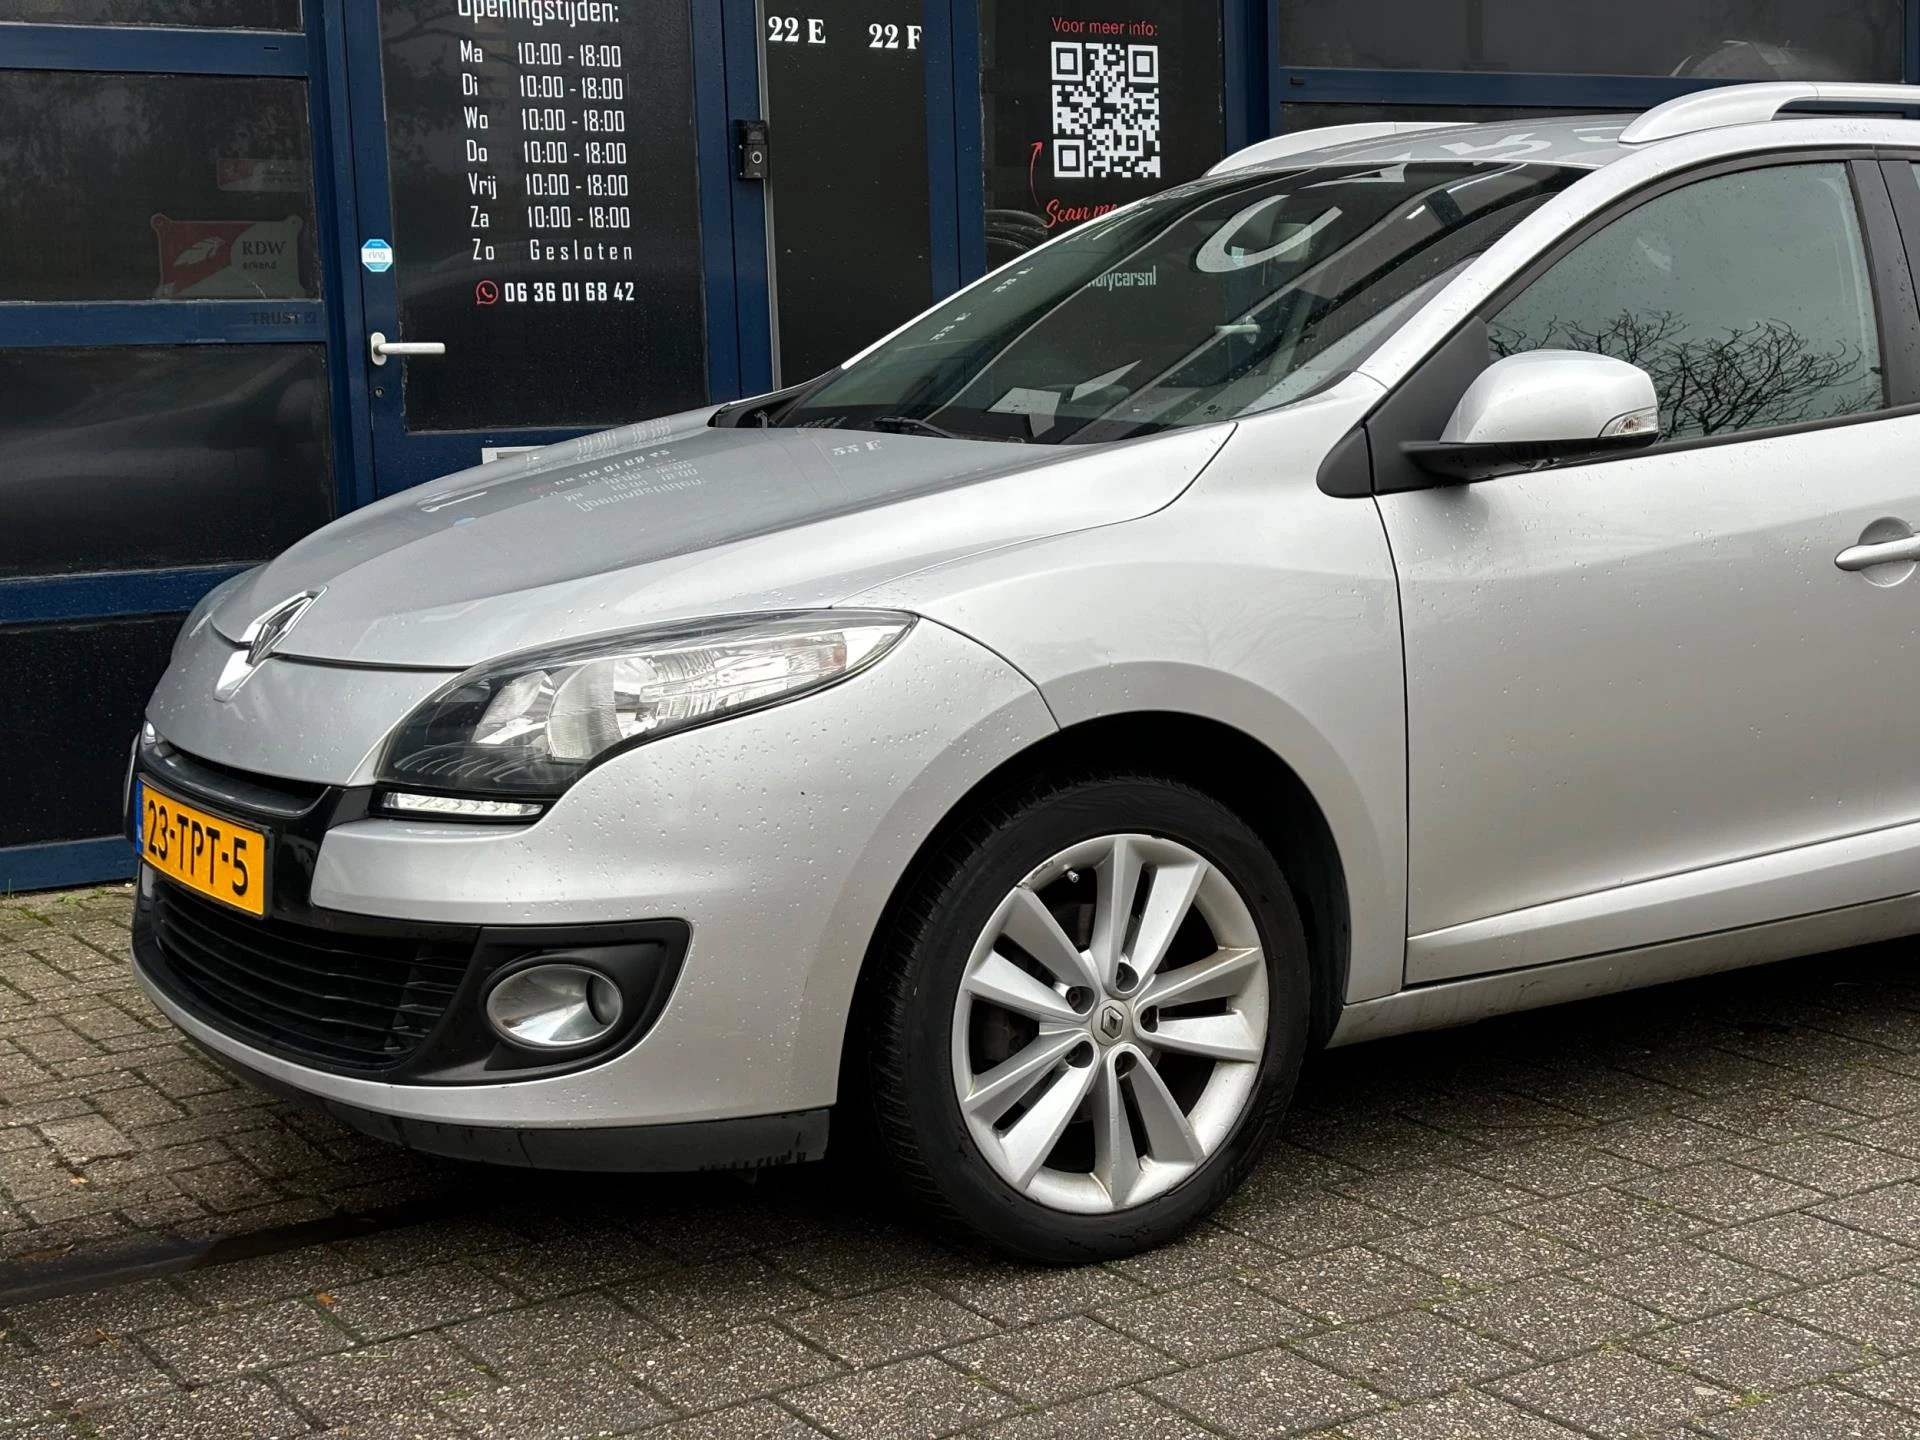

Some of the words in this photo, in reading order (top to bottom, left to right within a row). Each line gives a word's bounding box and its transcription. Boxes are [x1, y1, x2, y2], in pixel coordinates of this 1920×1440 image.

[767, 15, 800, 43] 22
[807, 18, 826, 44] E
[868, 23, 899, 49] 22
[906, 25, 923, 50] F
[1051, 16, 1086, 33] Voor
[1089, 21, 1125, 35] meer
[1128, 19, 1158, 37] info:
[459, 39, 484, 63] Ma
[517, 41, 562, 66] 10:00
[579, 44, 622, 68] 18:00
[462, 72, 479, 96] Di
[519, 74, 564, 99] 10:00
[581, 76, 624, 100] 18:00
[463, 106, 489, 130] Wo
[521, 108, 566, 132] 10:00
[583, 109, 625, 133] 18:00
[466, 139, 488, 162] Do
[523, 140, 568, 164] 10:00
[585, 141, 627, 165] 18:00
[467, 172, 497, 200] Vrij
[525, 173, 570, 196] 10:00
[587, 174, 629, 197] 18:00
[470, 205, 490, 228] Za
[527, 205, 572, 228] 10:00
[589, 206, 631, 229] 18:00
[1043, 199, 1090, 229] Scan
[242, 240, 286, 256] RDW
[472, 238, 495, 261] Zo
[529, 238, 633, 261] Gesloten
[1088, 264, 1157, 291] olycarsnl
[504, 282, 528, 303] 06
[533, 282, 556, 302] 36
[562, 282, 580, 302] 01
[585, 281, 608, 302] 68
[613, 281, 635, 301] 42
[148, 799, 249, 897] 23-TPT-5
